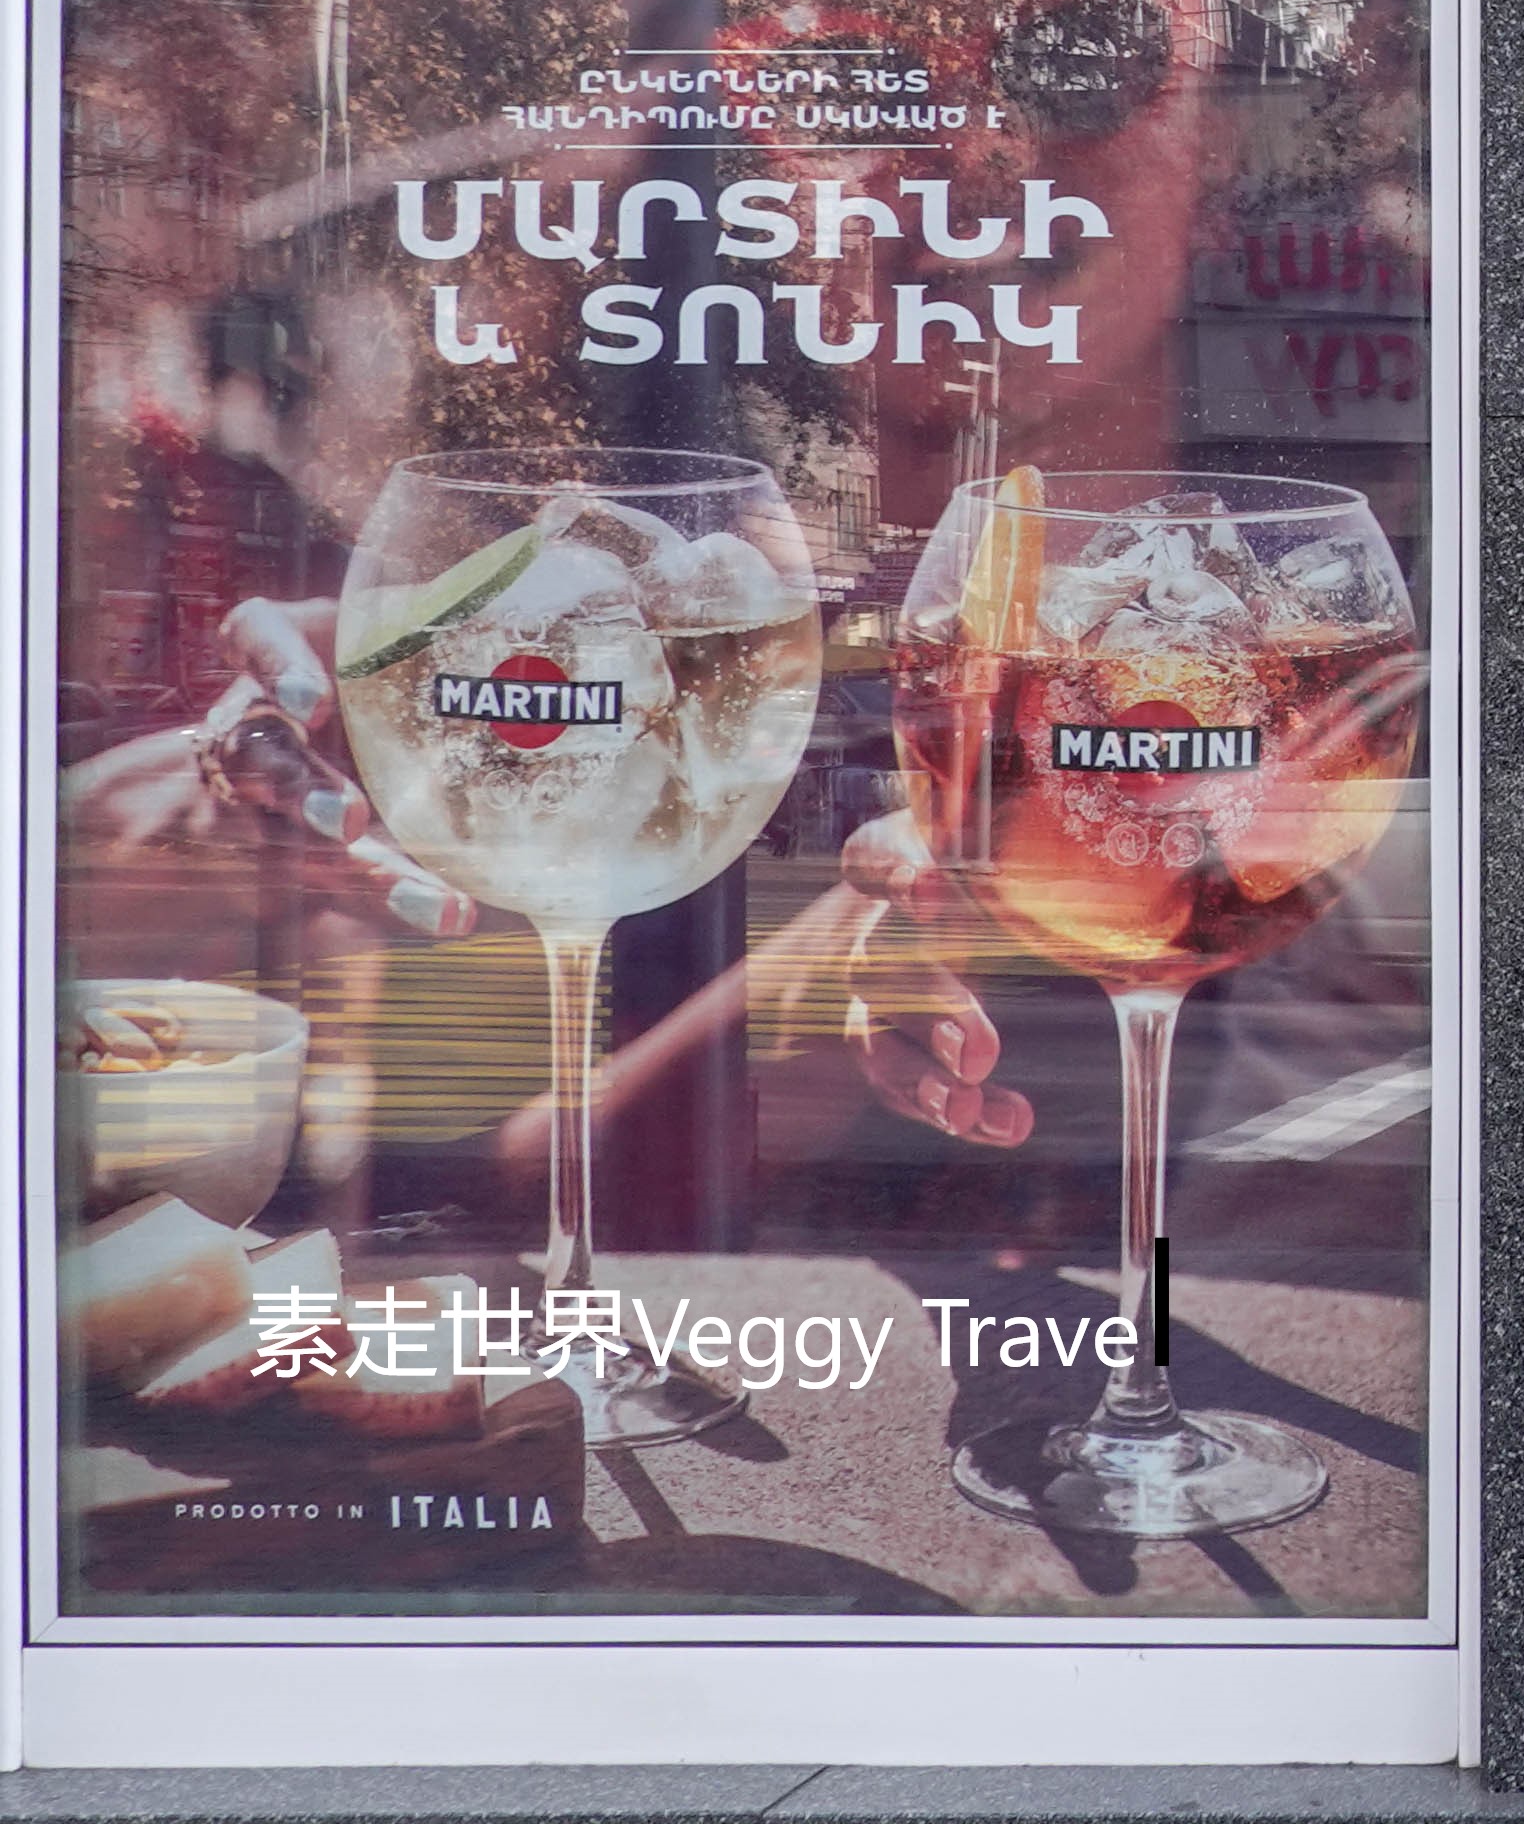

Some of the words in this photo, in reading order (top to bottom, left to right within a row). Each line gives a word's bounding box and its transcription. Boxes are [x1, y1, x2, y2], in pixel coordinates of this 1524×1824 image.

[578, 69, 839, 93] ԸՆԿԵՐՆԵՐԻ
[852, 69, 930, 93] ՀԵՏ
[796, 105, 968, 131] ՍԿՍՎԱԾ
[395, 178, 1114, 272] ՄԱՐՏԻՆԻ
[431, 284, 517, 365] և
[581, 284, 1083, 365] ՏՈՆԻԿ
[440, 674, 621, 721] MARTINI
[1059, 728, 1254, 770] MARTINI
[175, 1503, 320, 1520] PRODOTTO
[337, 1504, 364, 1519] IN
[391, 1494, 553, 1529] ITALIA
